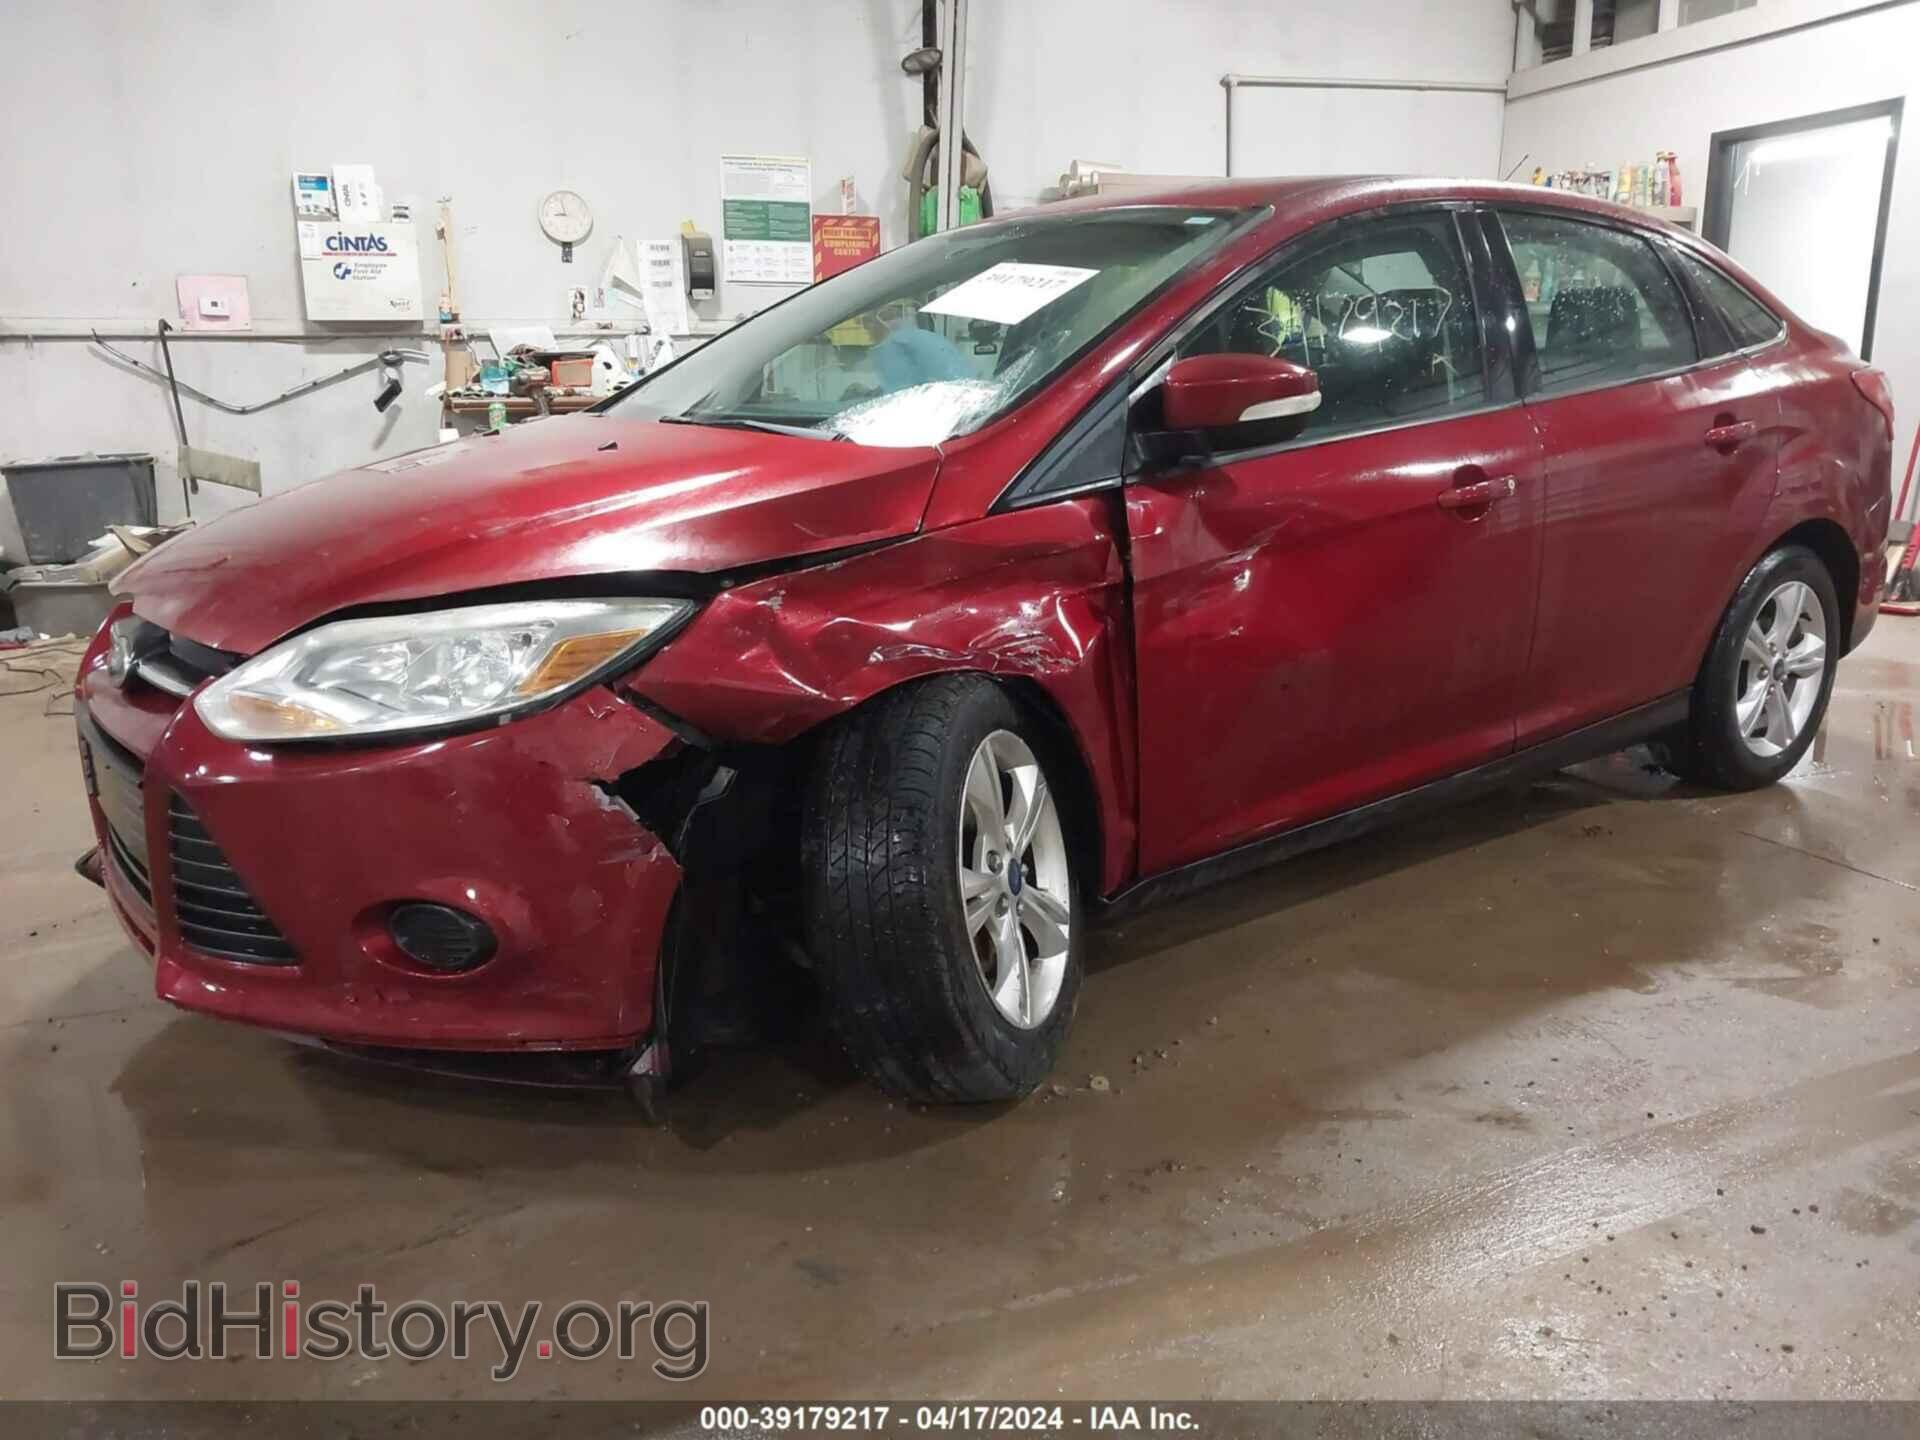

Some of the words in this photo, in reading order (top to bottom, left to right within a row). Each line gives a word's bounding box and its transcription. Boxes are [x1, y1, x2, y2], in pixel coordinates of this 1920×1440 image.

[326, 231, 388, 252] CINTAS
[824, 239, 870, 248] COMPLIANCE
[833, 248, 861, 256] CENTER
